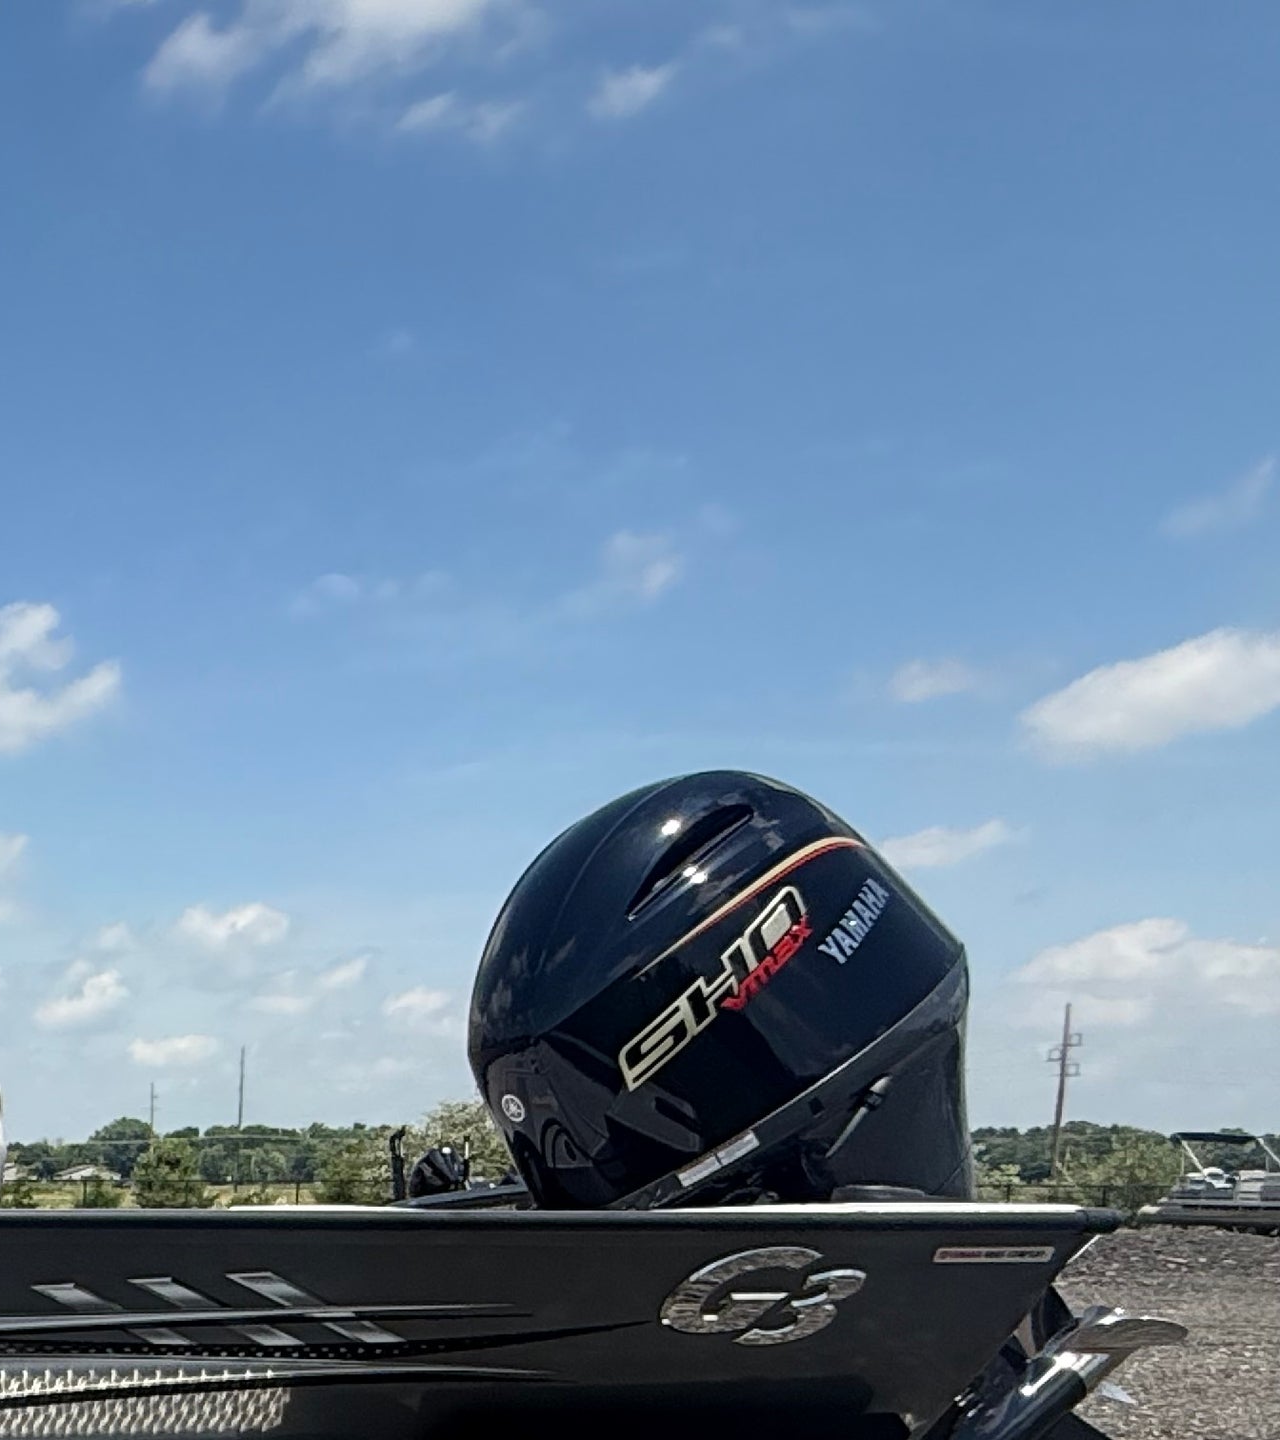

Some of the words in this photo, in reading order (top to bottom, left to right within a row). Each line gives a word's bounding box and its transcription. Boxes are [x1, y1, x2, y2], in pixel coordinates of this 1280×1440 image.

[818, 878, 889, 964] YAMAHA
[618, 885, 806, 1092] SHO
[660, 1246, 867, 1346] G3
